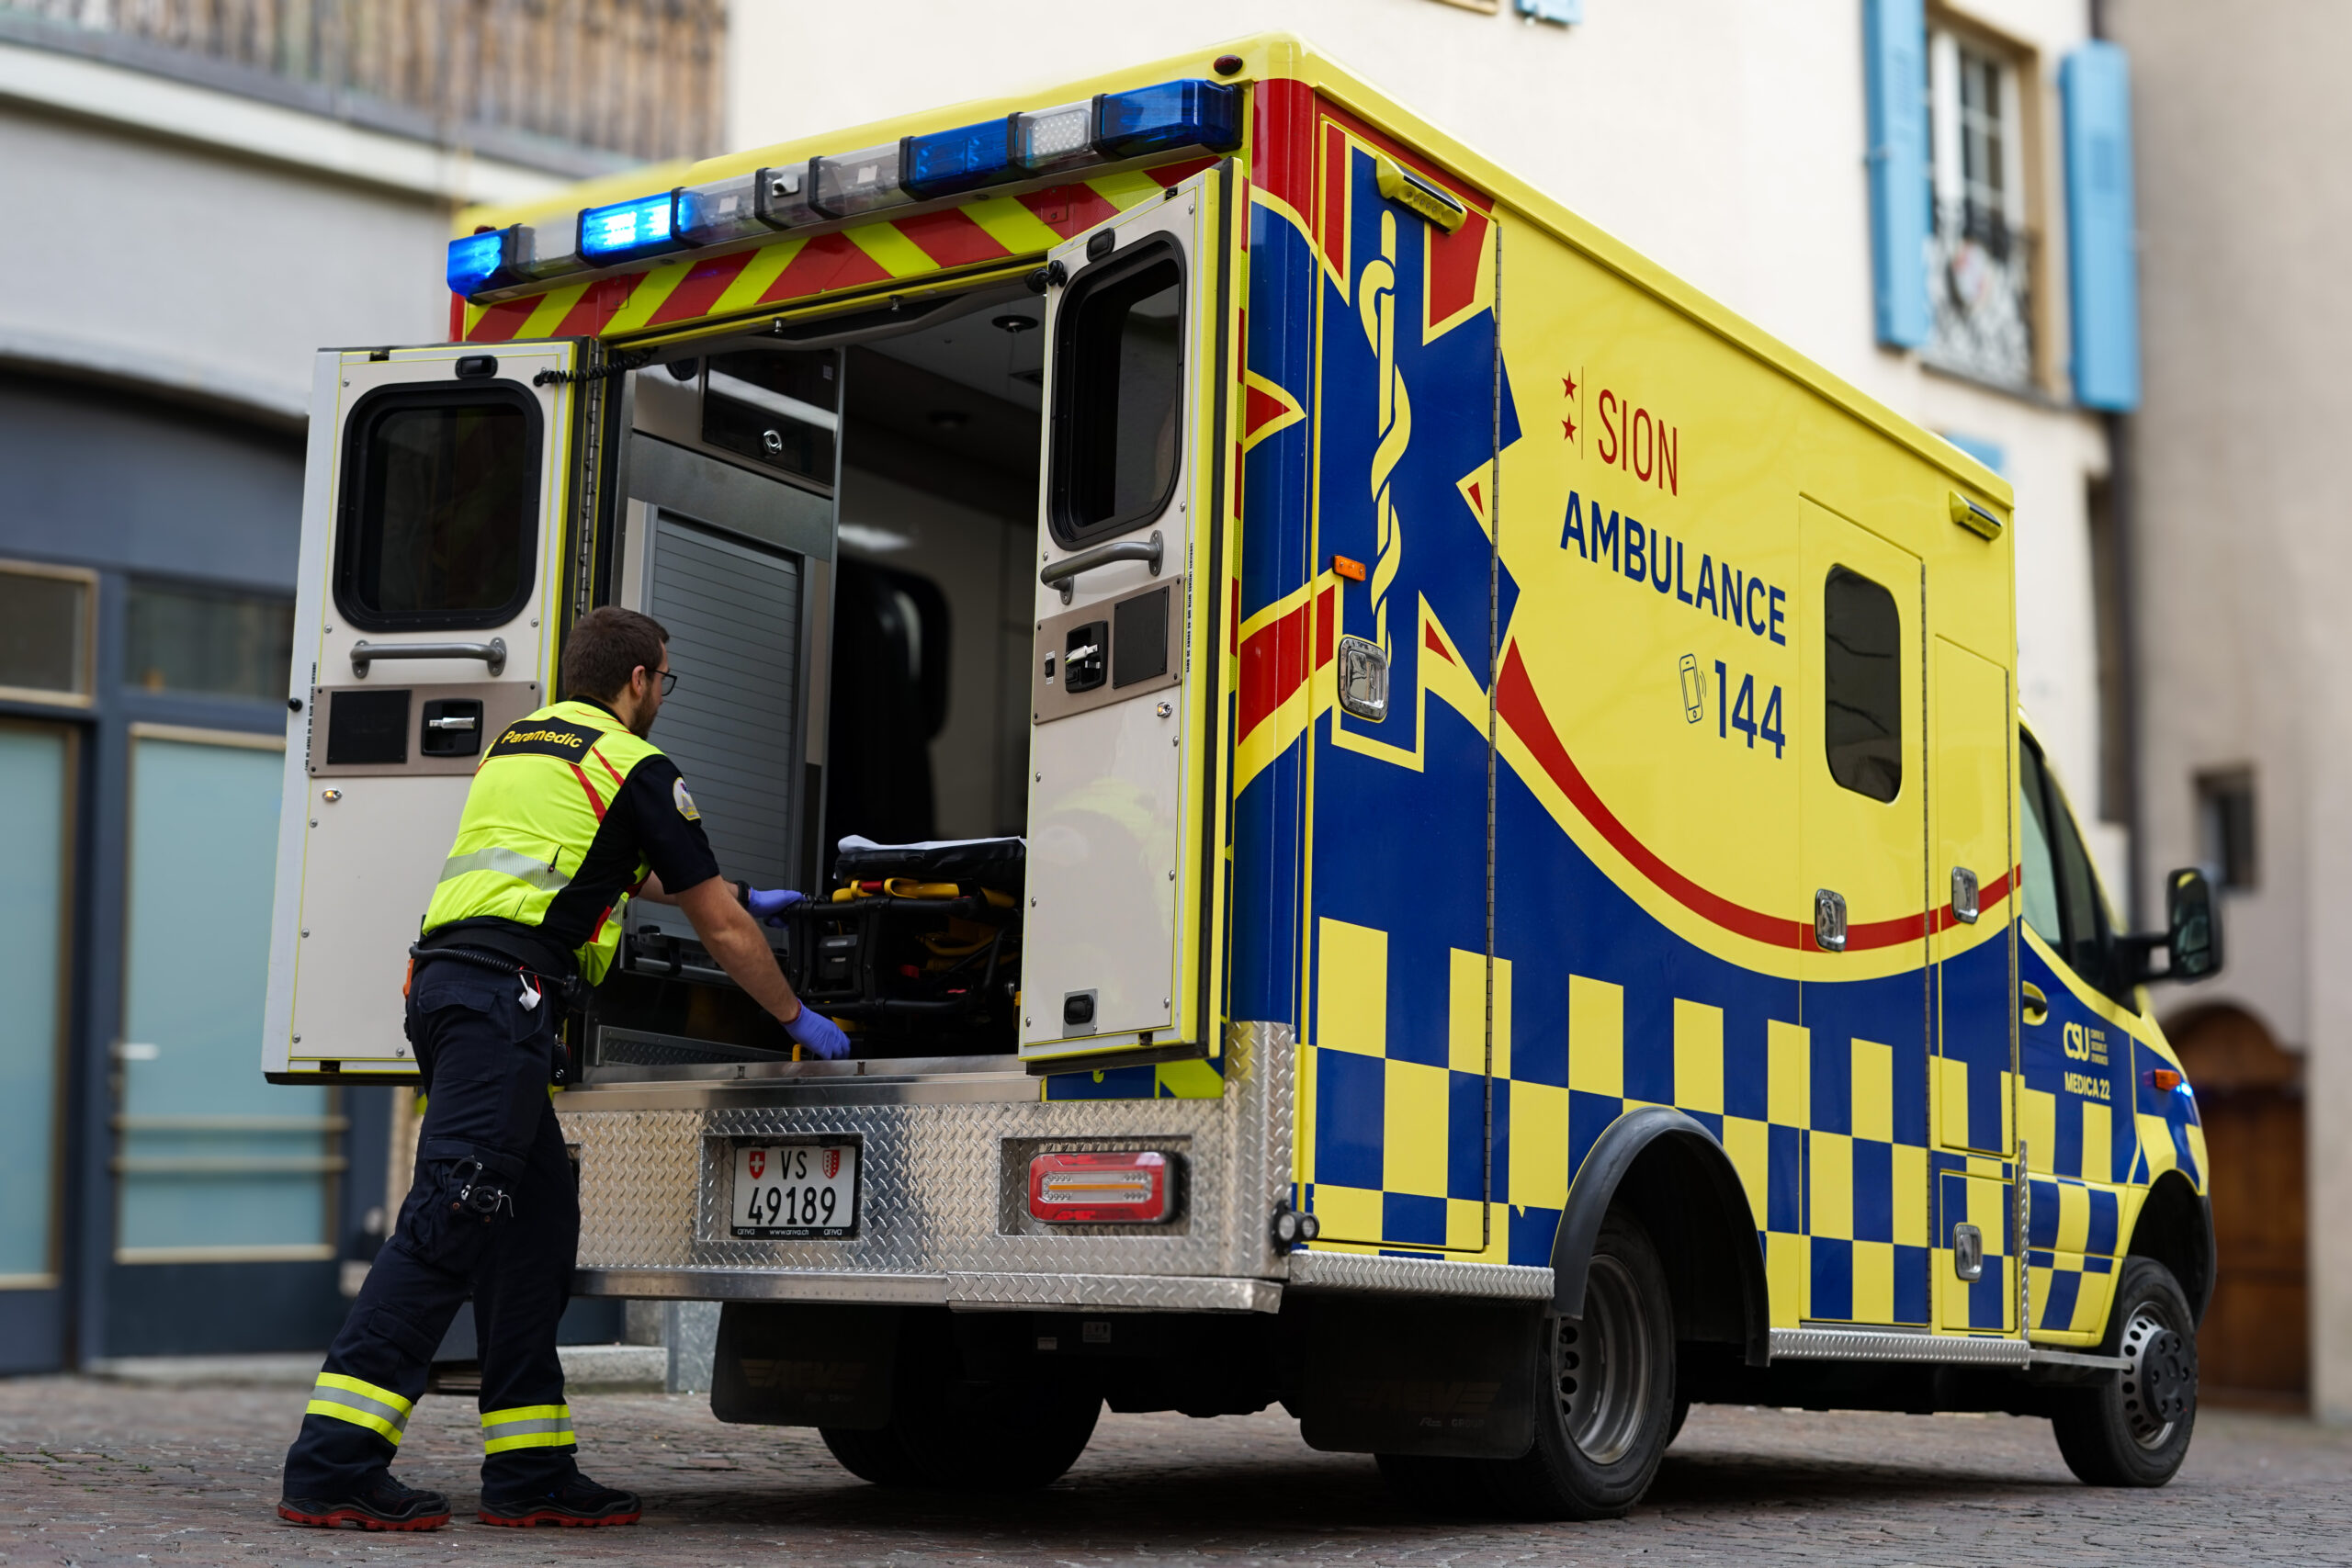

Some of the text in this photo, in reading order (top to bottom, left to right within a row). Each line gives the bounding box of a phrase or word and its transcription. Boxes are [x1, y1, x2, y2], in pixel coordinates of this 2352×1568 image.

[1598, 389, 1678, 497] SION
[1560, 490, 1786, 647] AMBULANCE
[1714, 659, 1786, 761] 144
[501, 729, 582, 749] Paramedic
[2063, 1021, 2090, 1062] CSU
[2064, 1071, 2111, 1100] MEDICA 22
[781, 1150, 808, 1180] VS
[748, 1186, 836, 1225] 49189
